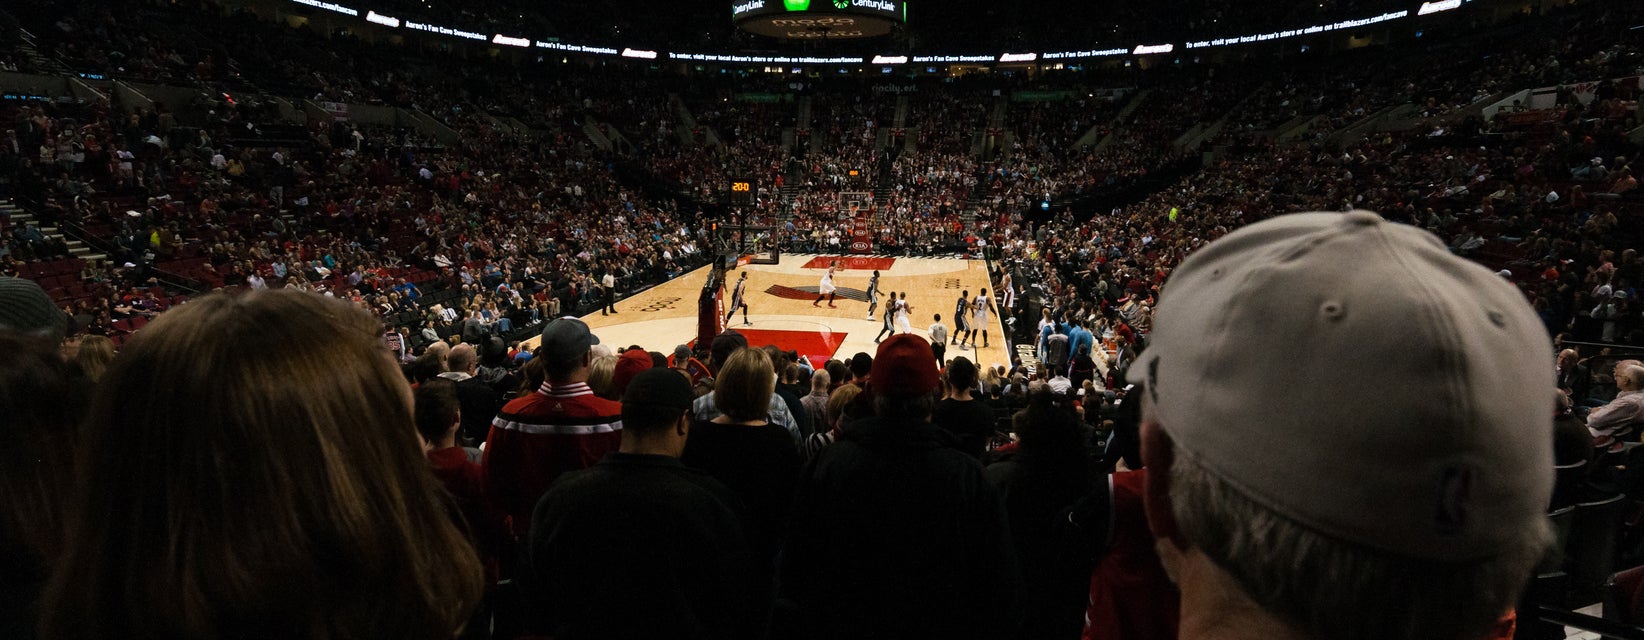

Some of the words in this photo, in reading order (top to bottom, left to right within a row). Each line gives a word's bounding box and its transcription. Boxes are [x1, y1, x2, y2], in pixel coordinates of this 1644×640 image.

[405, 20, 428, 31] Aaron's
[428, 24, 439, 33] Fan
[439, 26, 453, 36] Cave
[453, 29, 488, 41] Sweepstakes
[1193, 40, 1211, 48] enter,
[1211, 38, 1225, 46] visit
[1225, 37, 1240, 46] your
[1240, 35, 1257, 43] local
[1257, 32, 1280, 41] Aaron's
[1280, 29, 1296, 38] store
[1304, 25, 1324, 34] online
[1334, 10, 1409, 30] trailblazers.com/fancave
[536, 40, 556, 50] Aaron's
[557, 43, 567, 51] Fan
[567, 44, 581, 52] Cave
[582, 45, 618, 55] Sweepstakes
[1065, 51, 1076, 59] Fan
[1077, 50, 1091, 58] Cave
[1091, 48, 1128, 57] Sweepstakes
[960, 54, 994, 63] Sweepstakes
